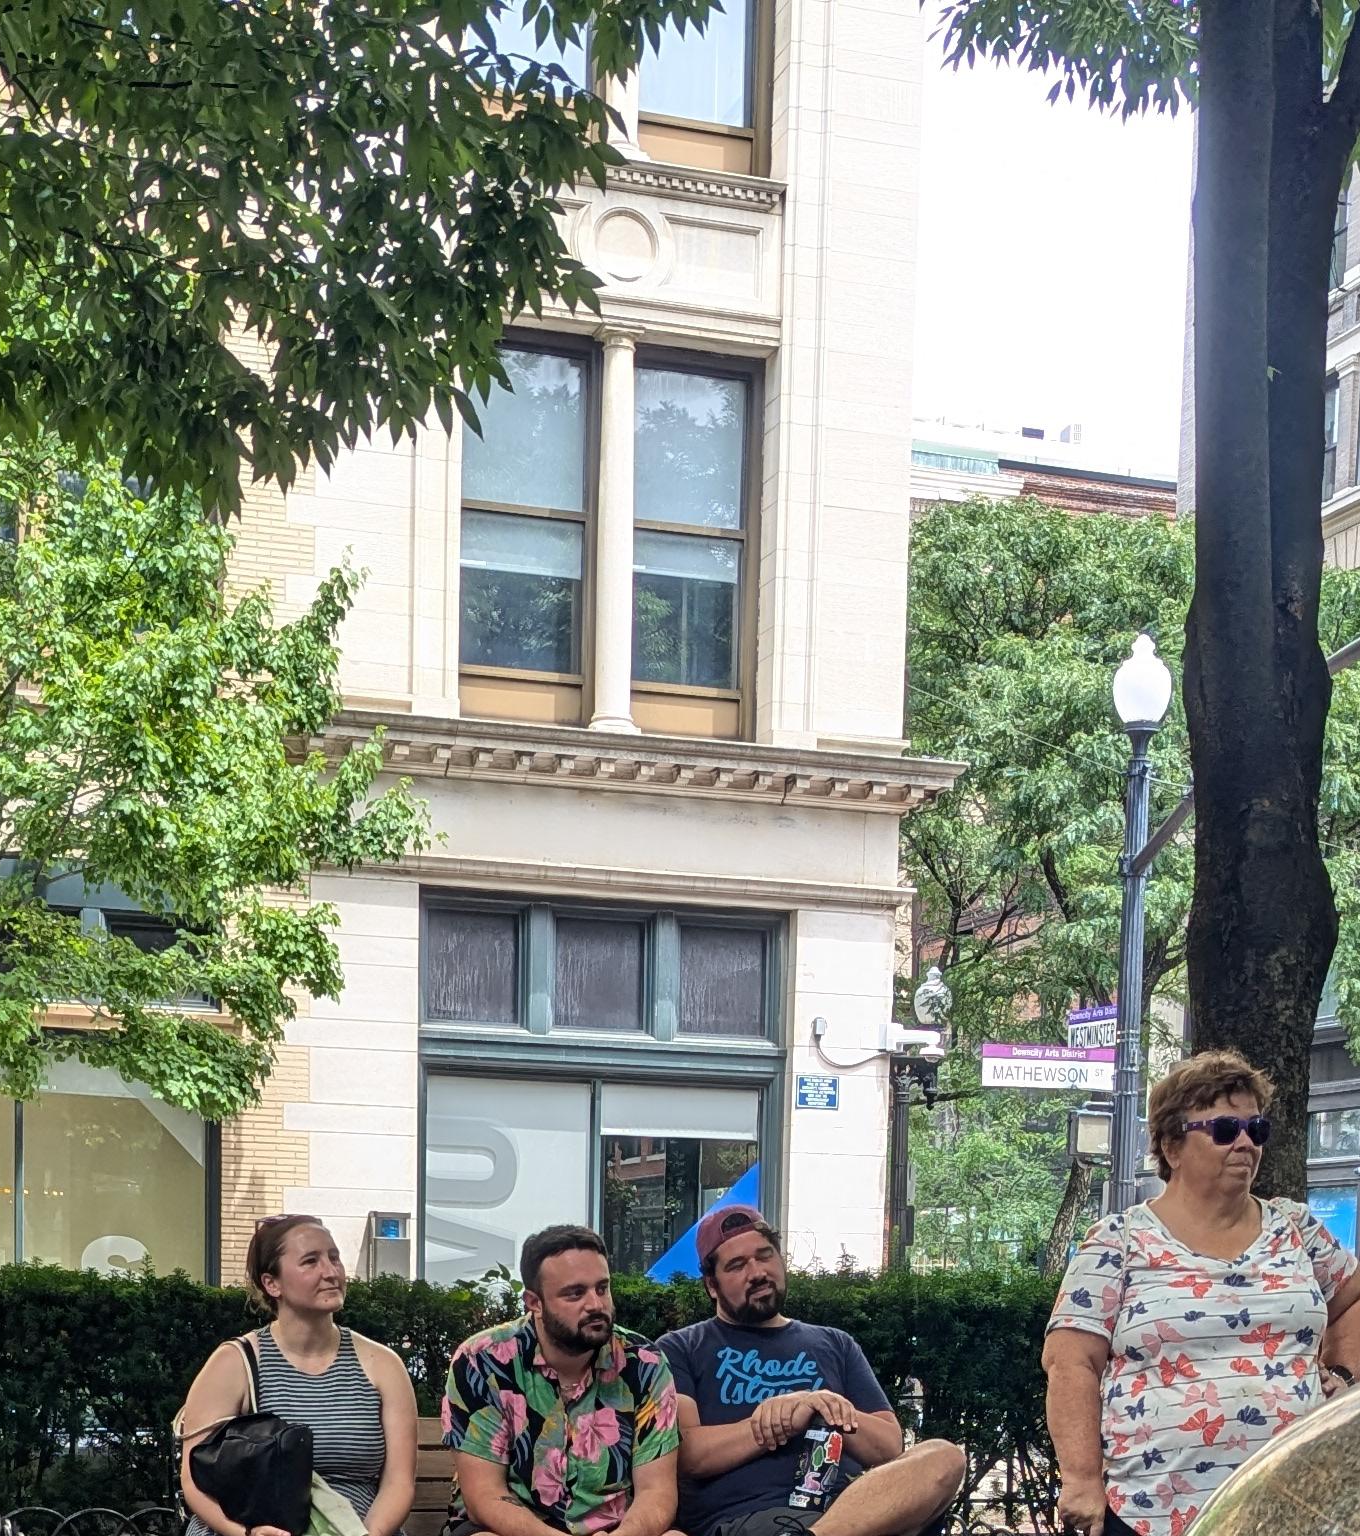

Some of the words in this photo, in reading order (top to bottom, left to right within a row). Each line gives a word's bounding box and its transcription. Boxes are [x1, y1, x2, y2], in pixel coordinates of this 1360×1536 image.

[1070, 1023, 1115, 1048] WESTMINSTER
[1044, 1047, 1059, 1057] Arts
[1061, 1048, 1086, 1059] District
[992, 1065, 1088, 1083] MATHEWSON
[1094, 1068, 1104, 1077] ST
[715, 1346, 819, 1387] Rhode
[720, 1374, 824, 1405] Isla
